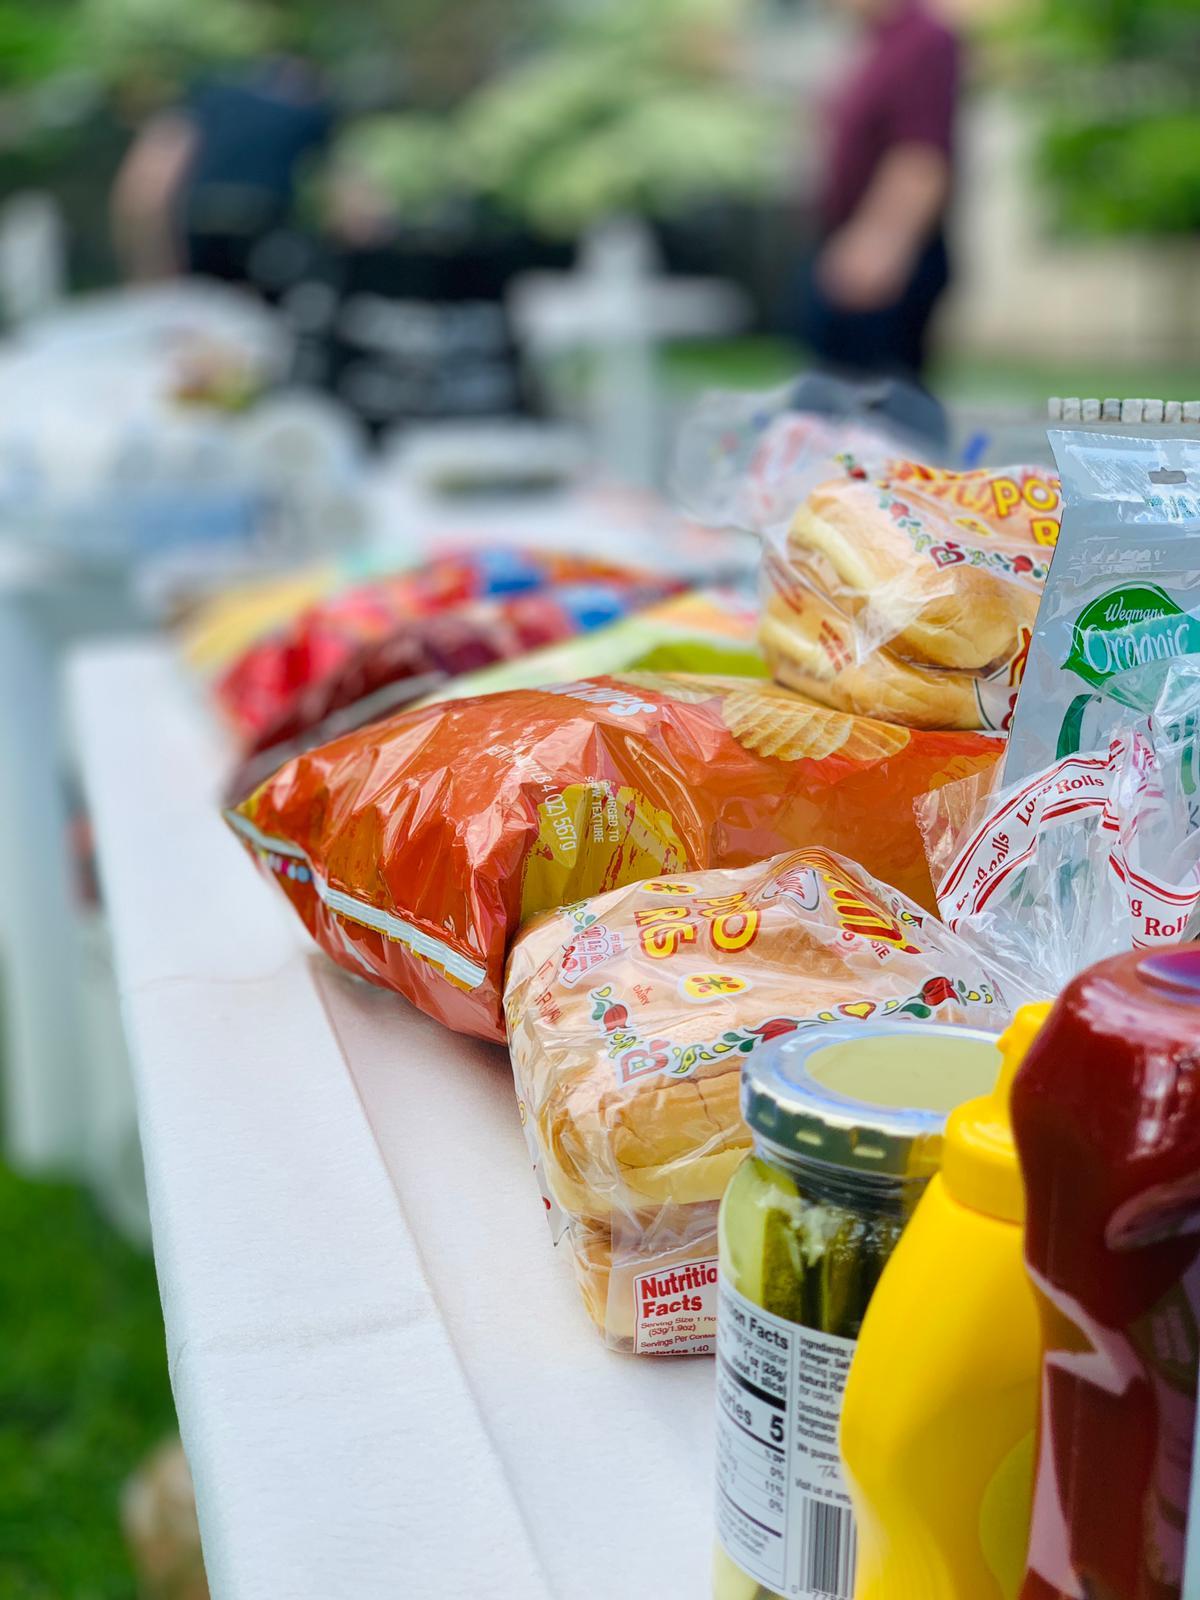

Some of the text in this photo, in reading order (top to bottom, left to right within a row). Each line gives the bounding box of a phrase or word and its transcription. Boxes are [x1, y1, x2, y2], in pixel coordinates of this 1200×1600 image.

[992, 476, 1060, 518] PO
[1104, 596, 1165, 624] Wegmans
[1084, 623, 1190, 674] Organic
[1055, 775, 1104, 795] Rolls
[541, 784, 559, 793] 4
[553, 816, 577, 851] 567g
[592, 800, 604, 843] TEXTURE
[608, 830, 619, 842] TO
[1144, 913, 1189, 937] Roll
[633, 984, 650, 1006] DAIRY
[641, 1264, 718, 1299] Nutritio
[643, 1294, 703, 1318] Facts
[641, 1338, 674, 1348] Servings
[674, 1334, 688, 1344] Per
[749, 1316, 788, 1350] Facts
[692, 1344, 709, 1353] 140
[769, 1413, 785, 1443] 5
